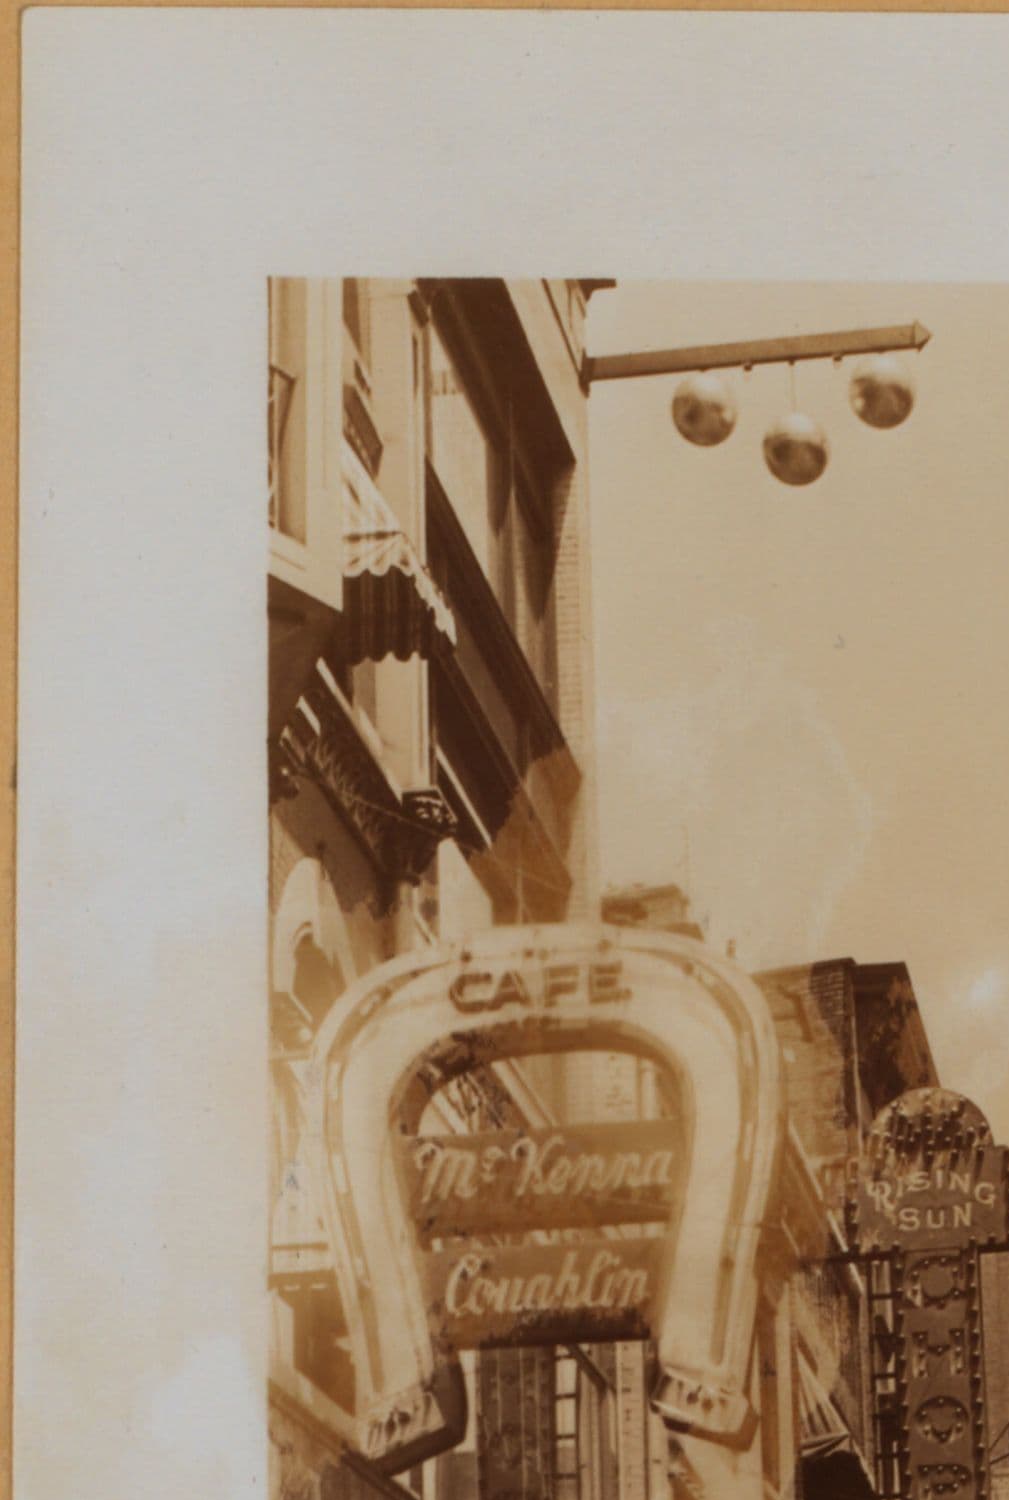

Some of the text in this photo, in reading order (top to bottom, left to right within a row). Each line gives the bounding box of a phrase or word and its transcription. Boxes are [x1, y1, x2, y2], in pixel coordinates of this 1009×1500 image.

[449, 961, 633, 1012] CAFE
[866, 1169, 996, 1211] RISING
[899, 1203, 973, 1232] SUN
